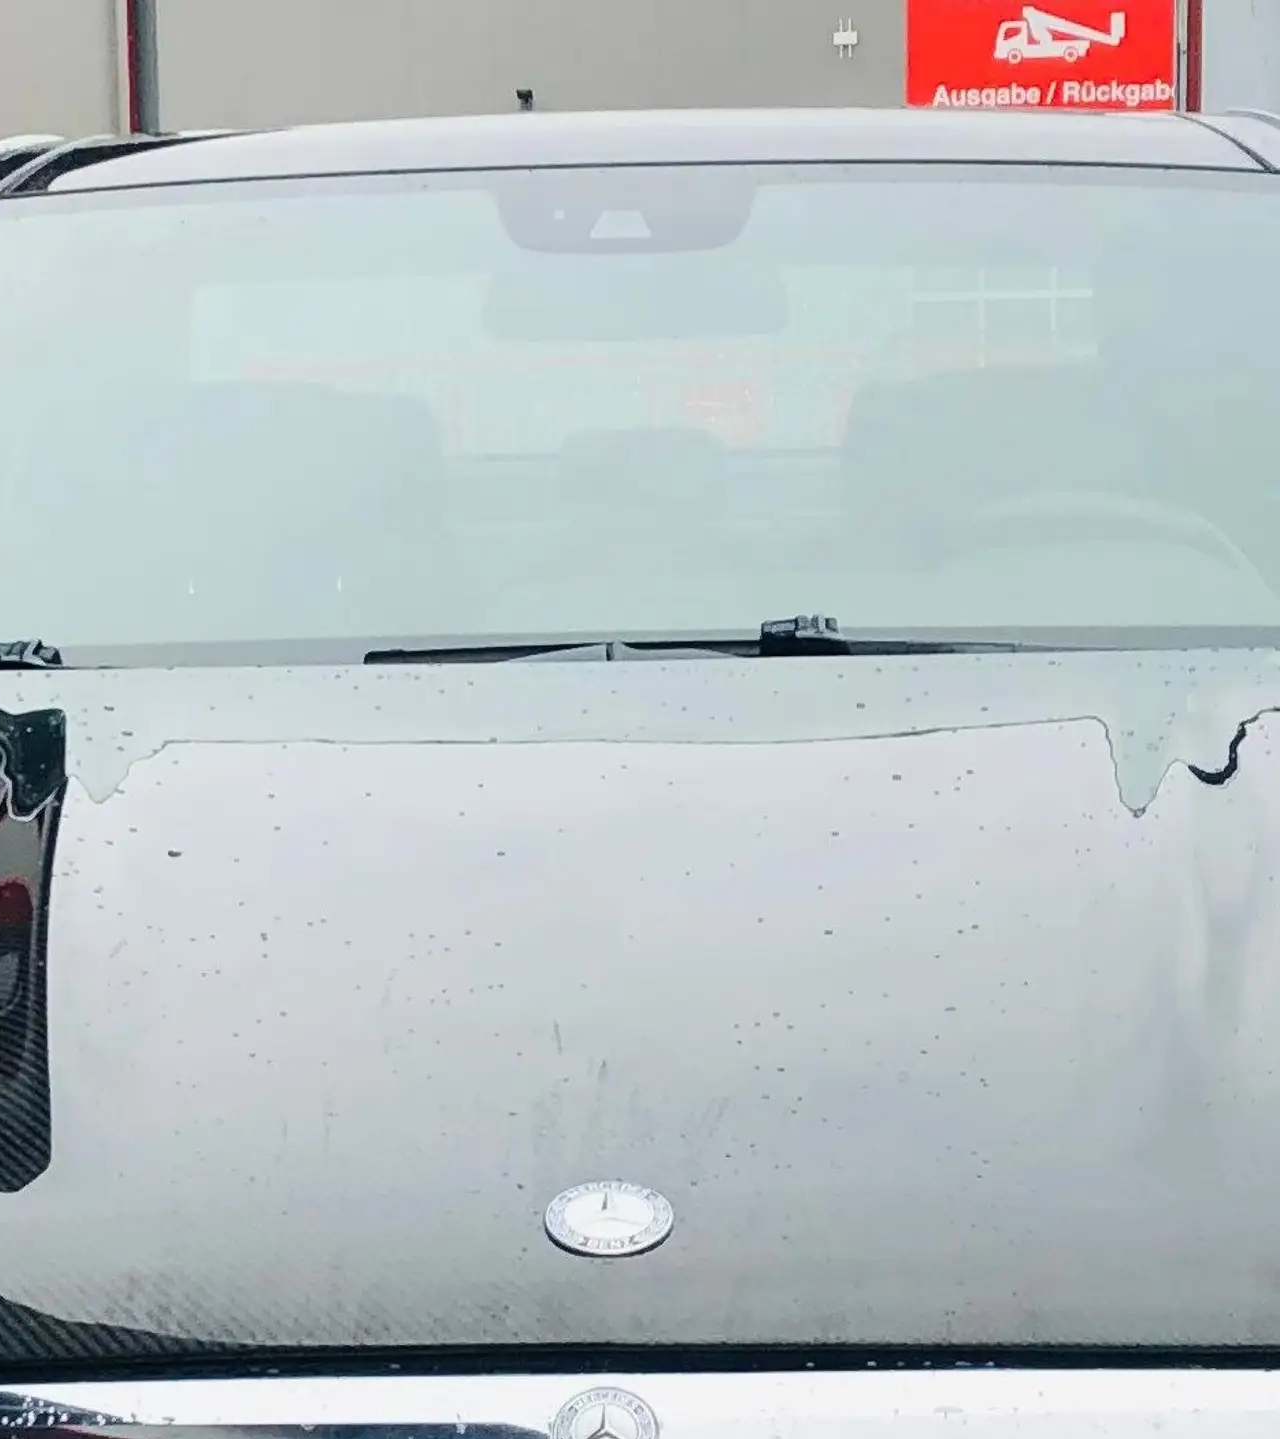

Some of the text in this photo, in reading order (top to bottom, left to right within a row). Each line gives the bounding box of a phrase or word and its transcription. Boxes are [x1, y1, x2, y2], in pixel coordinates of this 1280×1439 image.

[932, 78, 1176, 108] Ausgabe / Rückgab
